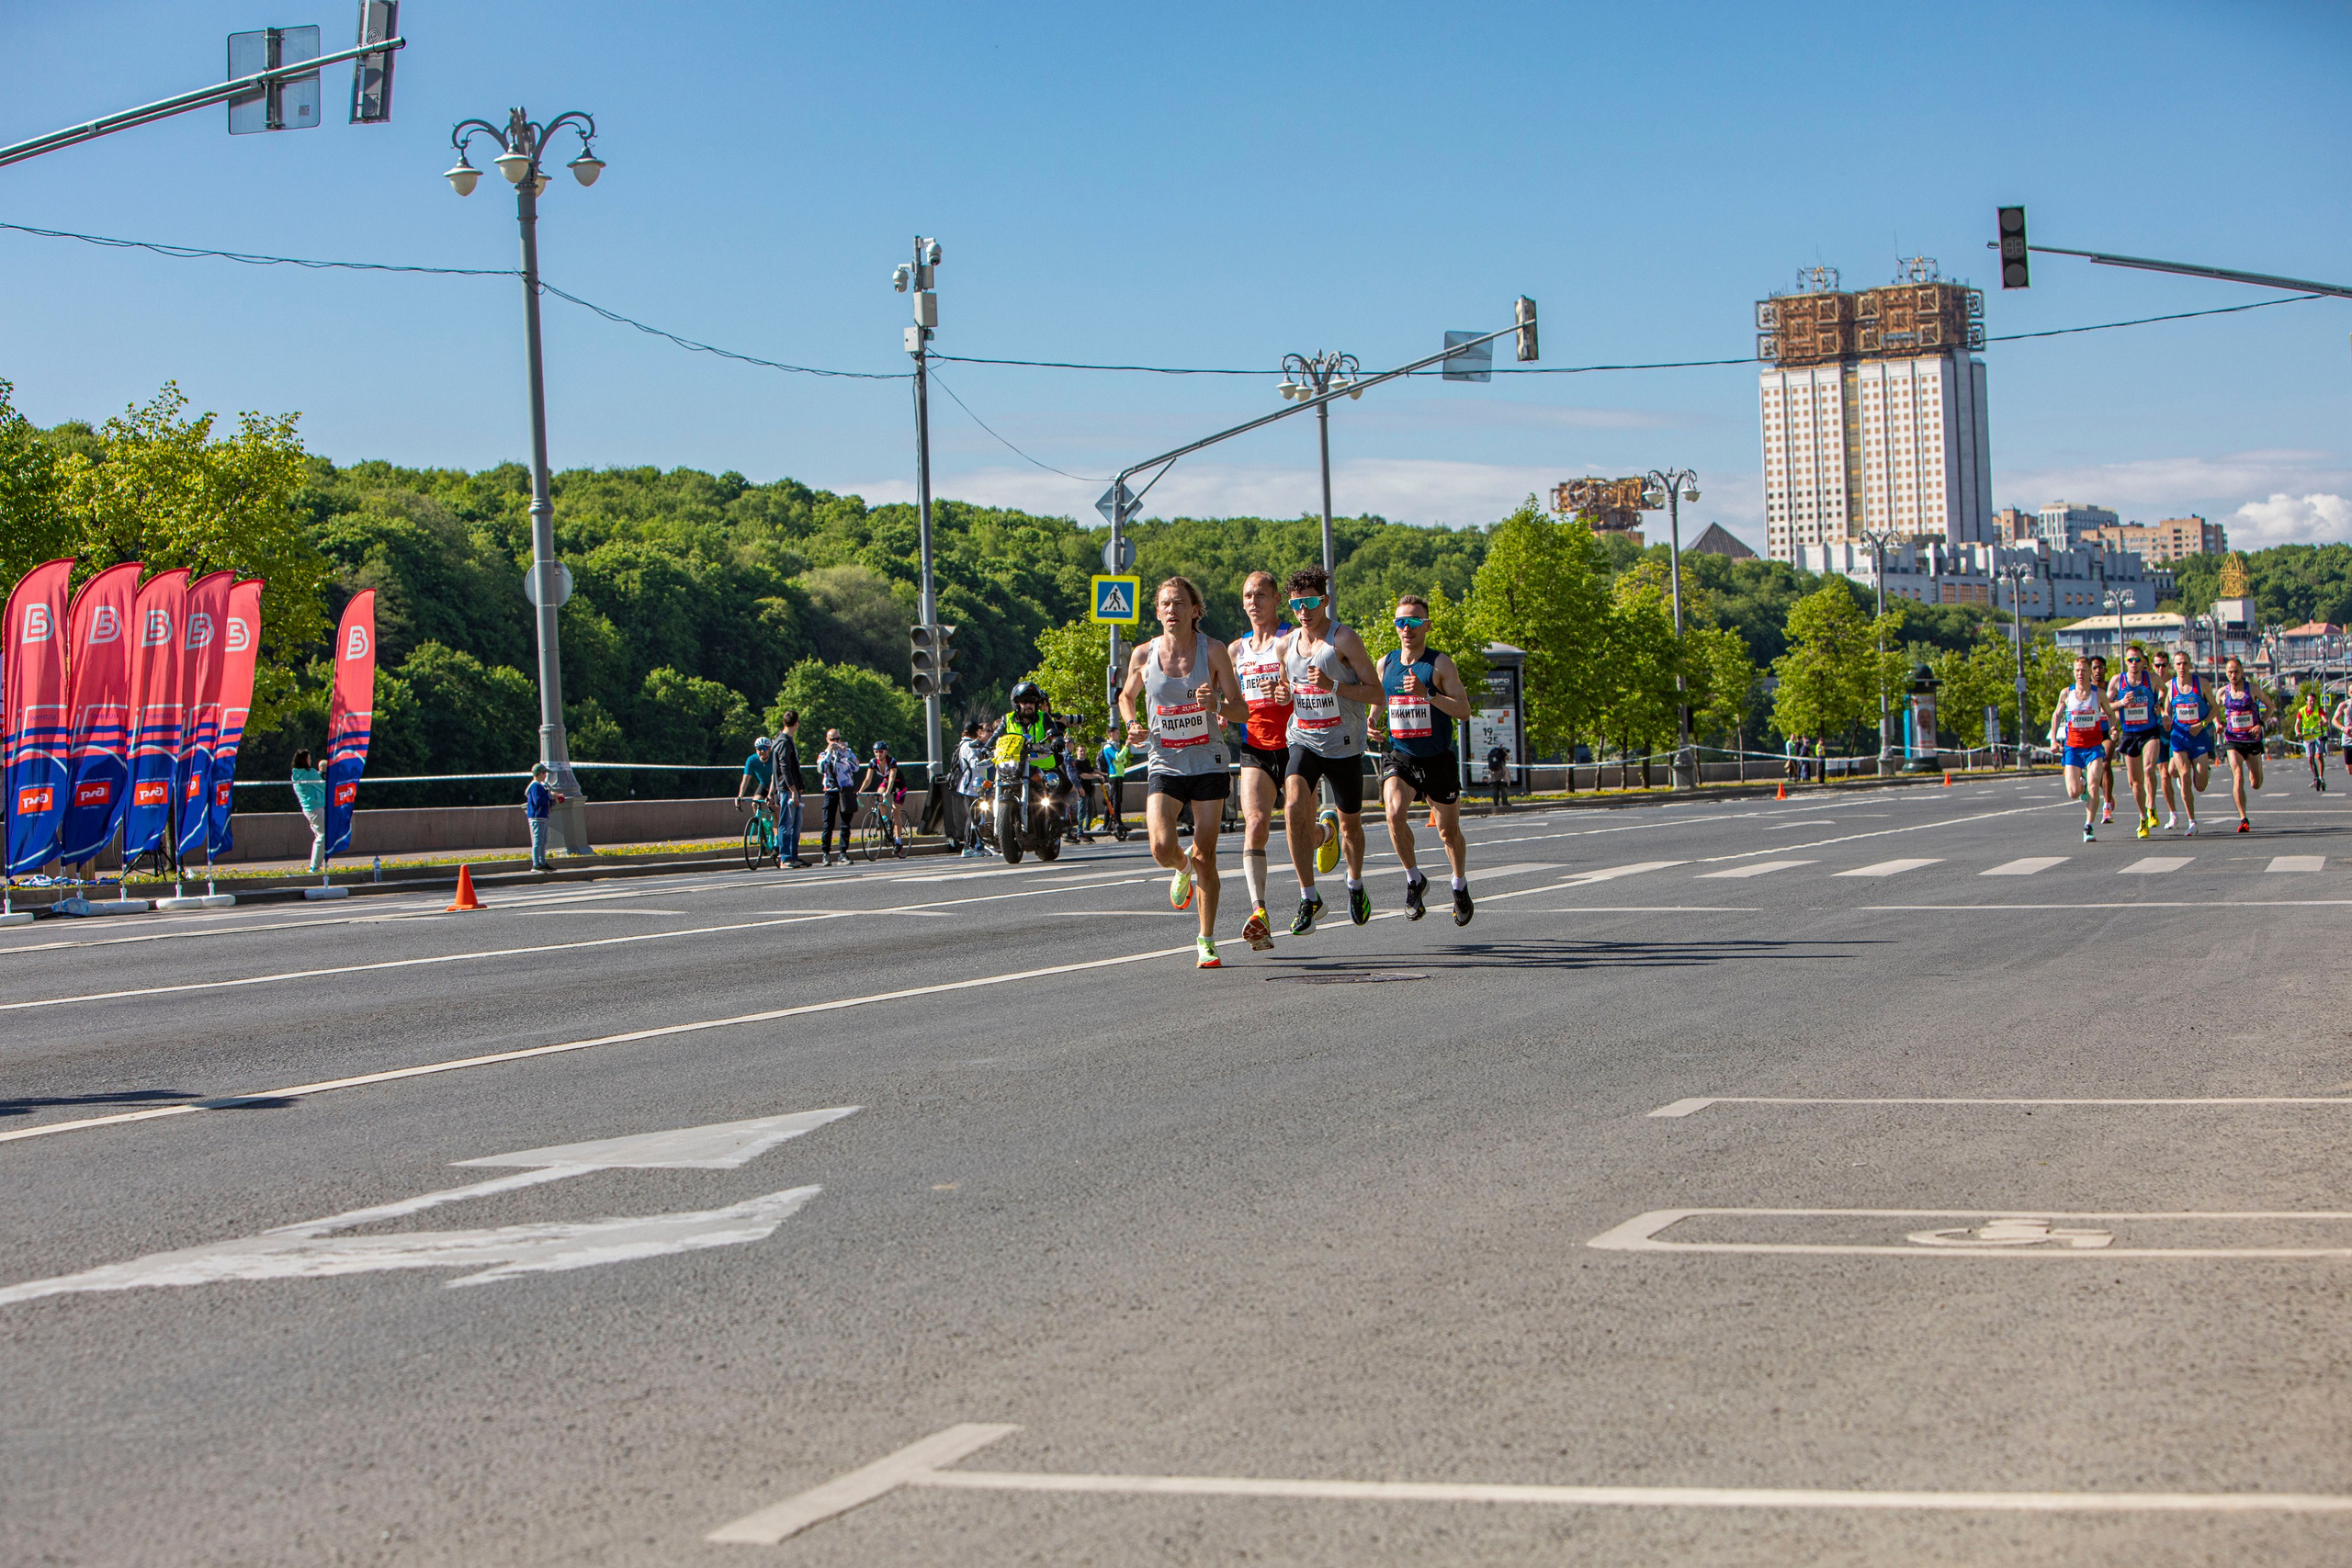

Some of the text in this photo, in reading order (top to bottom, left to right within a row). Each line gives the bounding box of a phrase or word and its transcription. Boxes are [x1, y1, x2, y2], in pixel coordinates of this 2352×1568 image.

[1246, 674, 1281, 690] ЛЕЙ
[1297, 696, 1334, 710] НЕДЕЛИН
[1390, 708, 1427, 718] НИКИТИН
[1161, 716, 1203, 731] ЯДГАРОВ
[1483, 728, 1493, 737] 19
